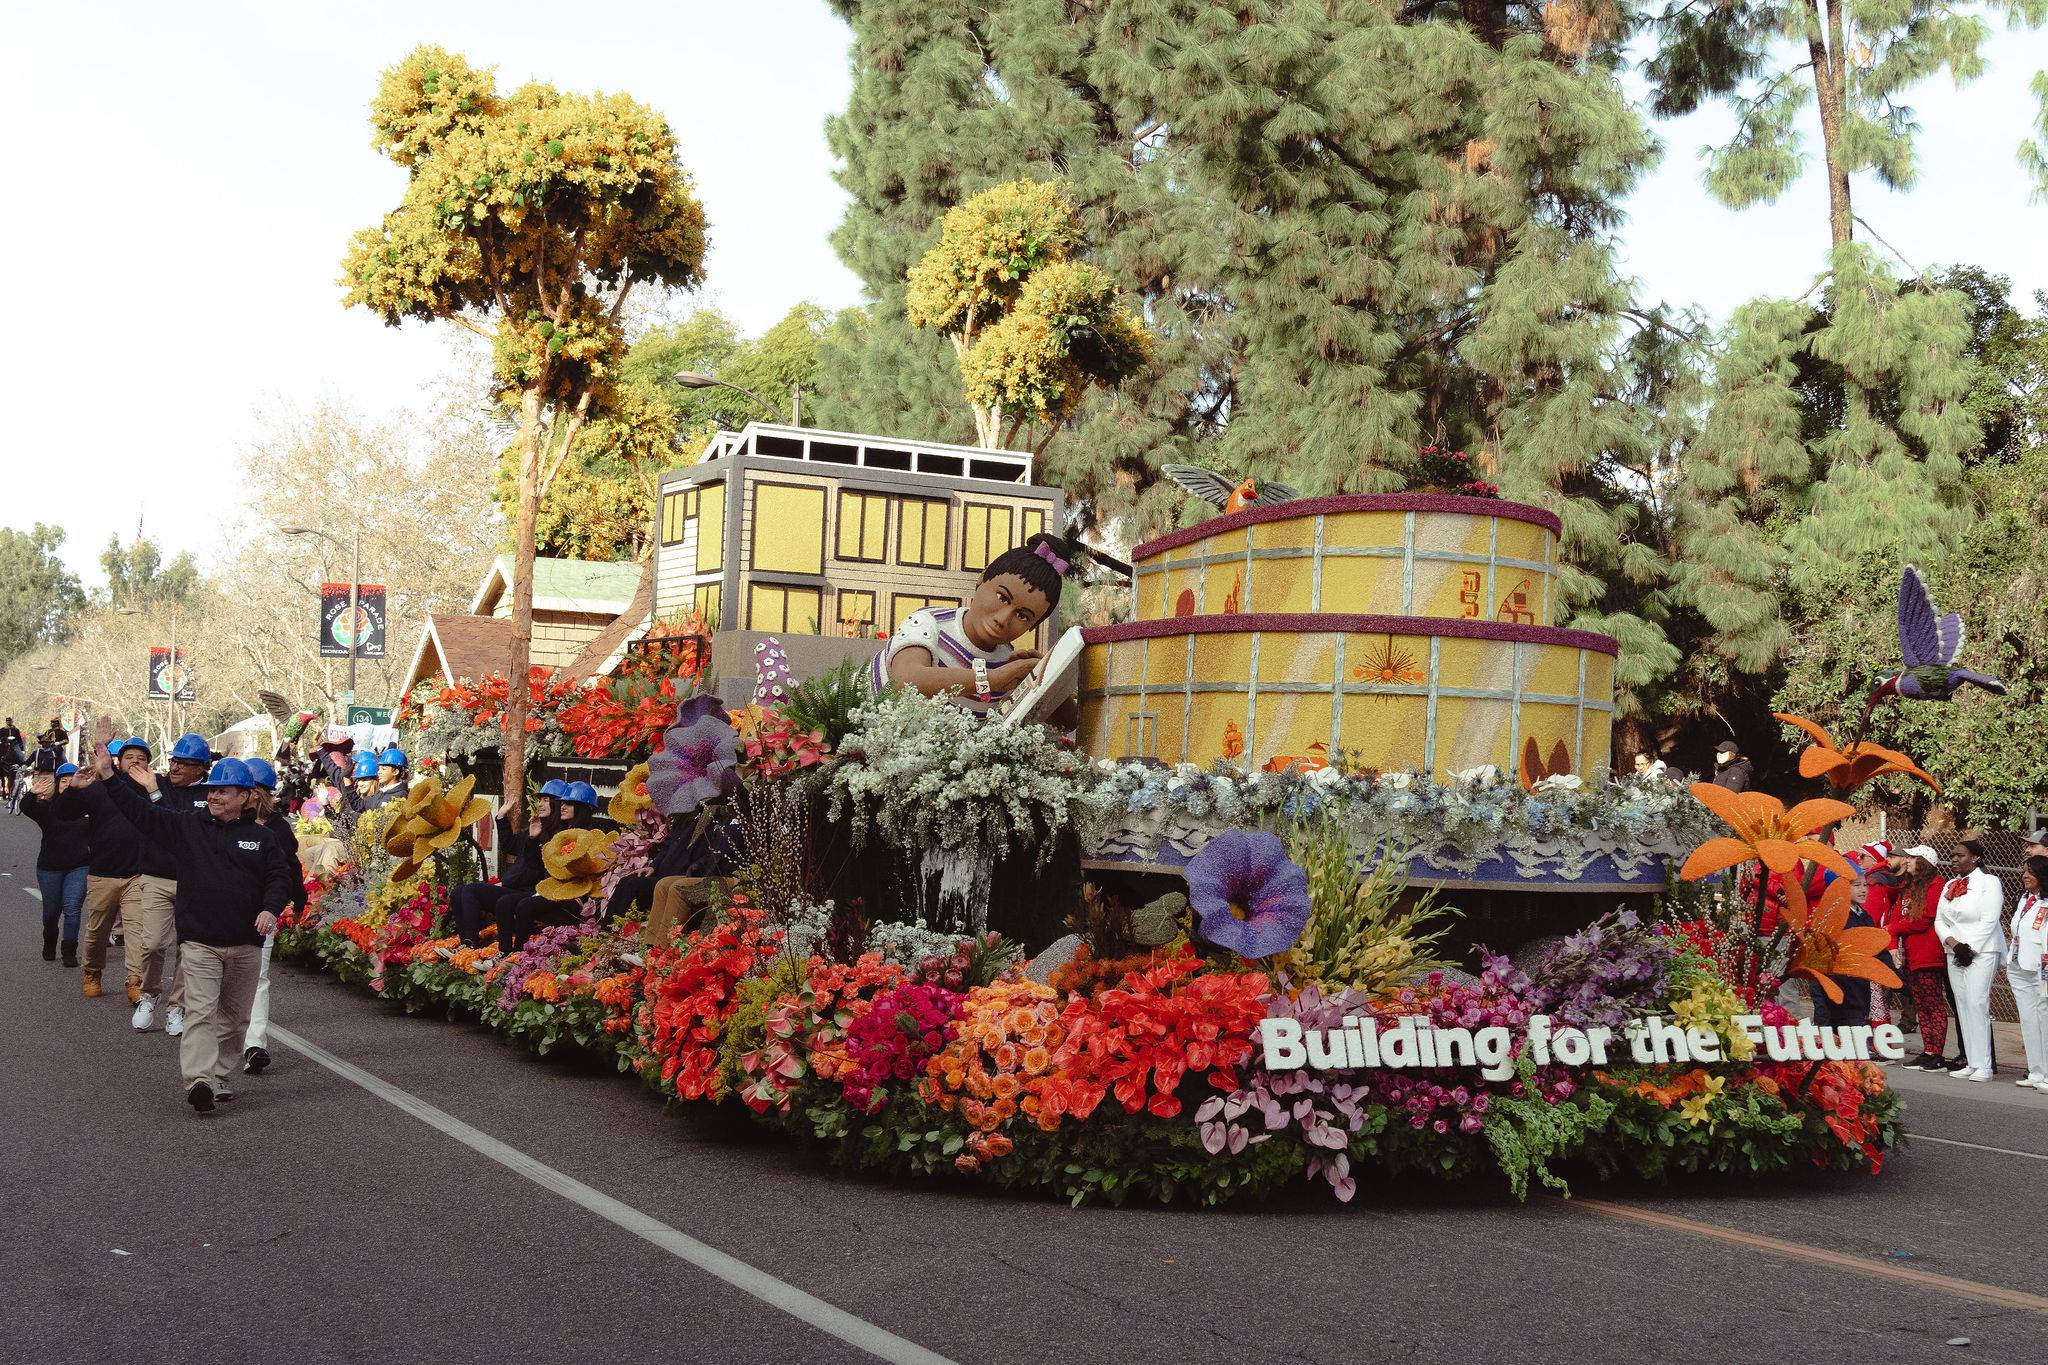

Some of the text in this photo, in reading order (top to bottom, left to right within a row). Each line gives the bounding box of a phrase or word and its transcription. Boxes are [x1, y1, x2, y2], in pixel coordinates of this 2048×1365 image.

[325, 600, 384, 630] ROSE PARADE
[356, 714, 370, 723] 134
[1260, 1014, 1905, 1082] Building for the Future
